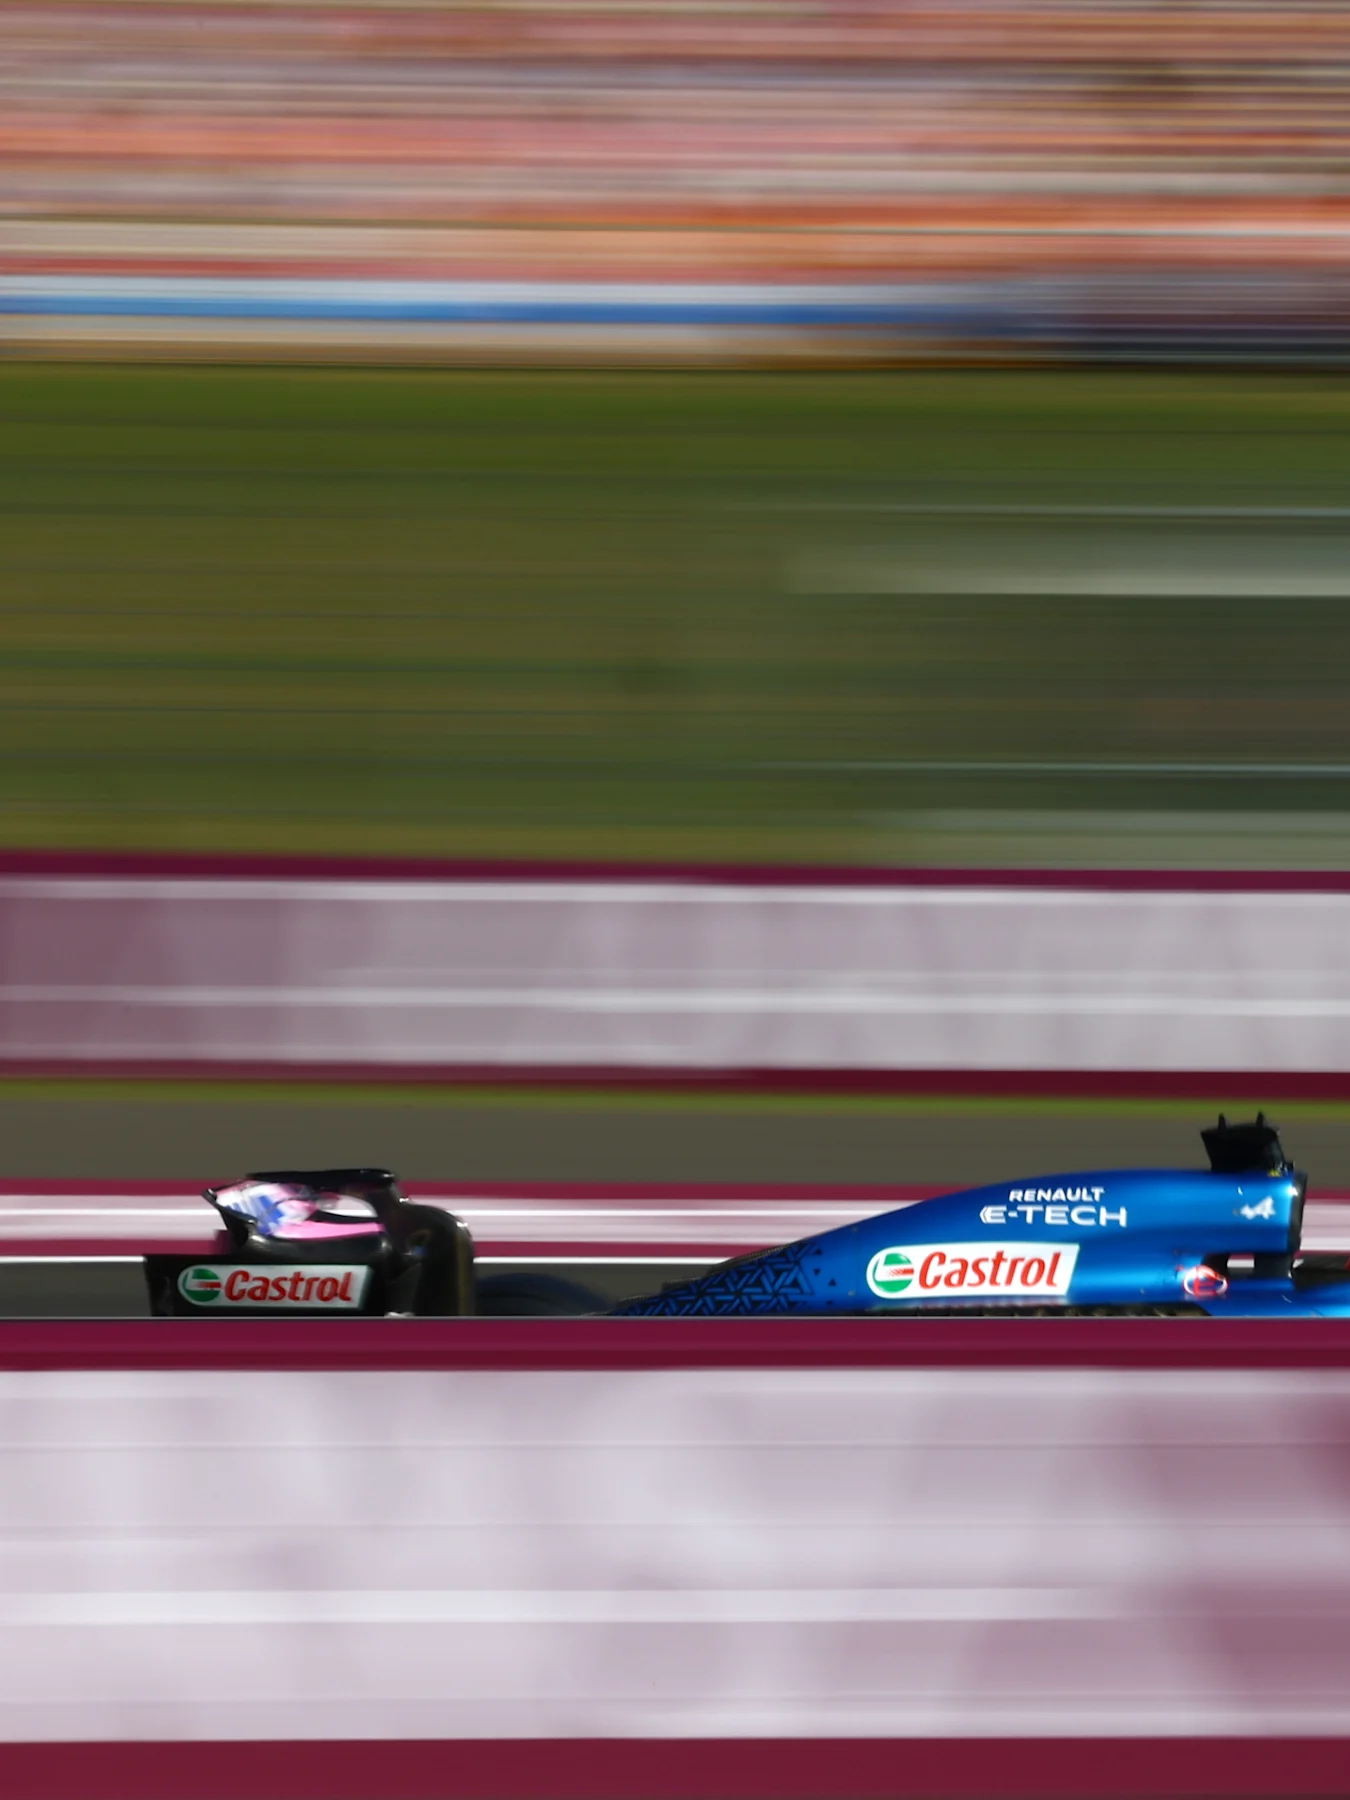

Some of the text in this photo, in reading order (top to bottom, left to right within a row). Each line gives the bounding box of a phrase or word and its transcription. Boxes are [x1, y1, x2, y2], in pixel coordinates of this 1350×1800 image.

[1009, 1186, 1105, 1202] RENAULT
[979, 1205, 1127, 1228] E-TECH
[918, 1249, 1062, 1290] Castrol
[224, 1270, 353, 1302] Castrol
